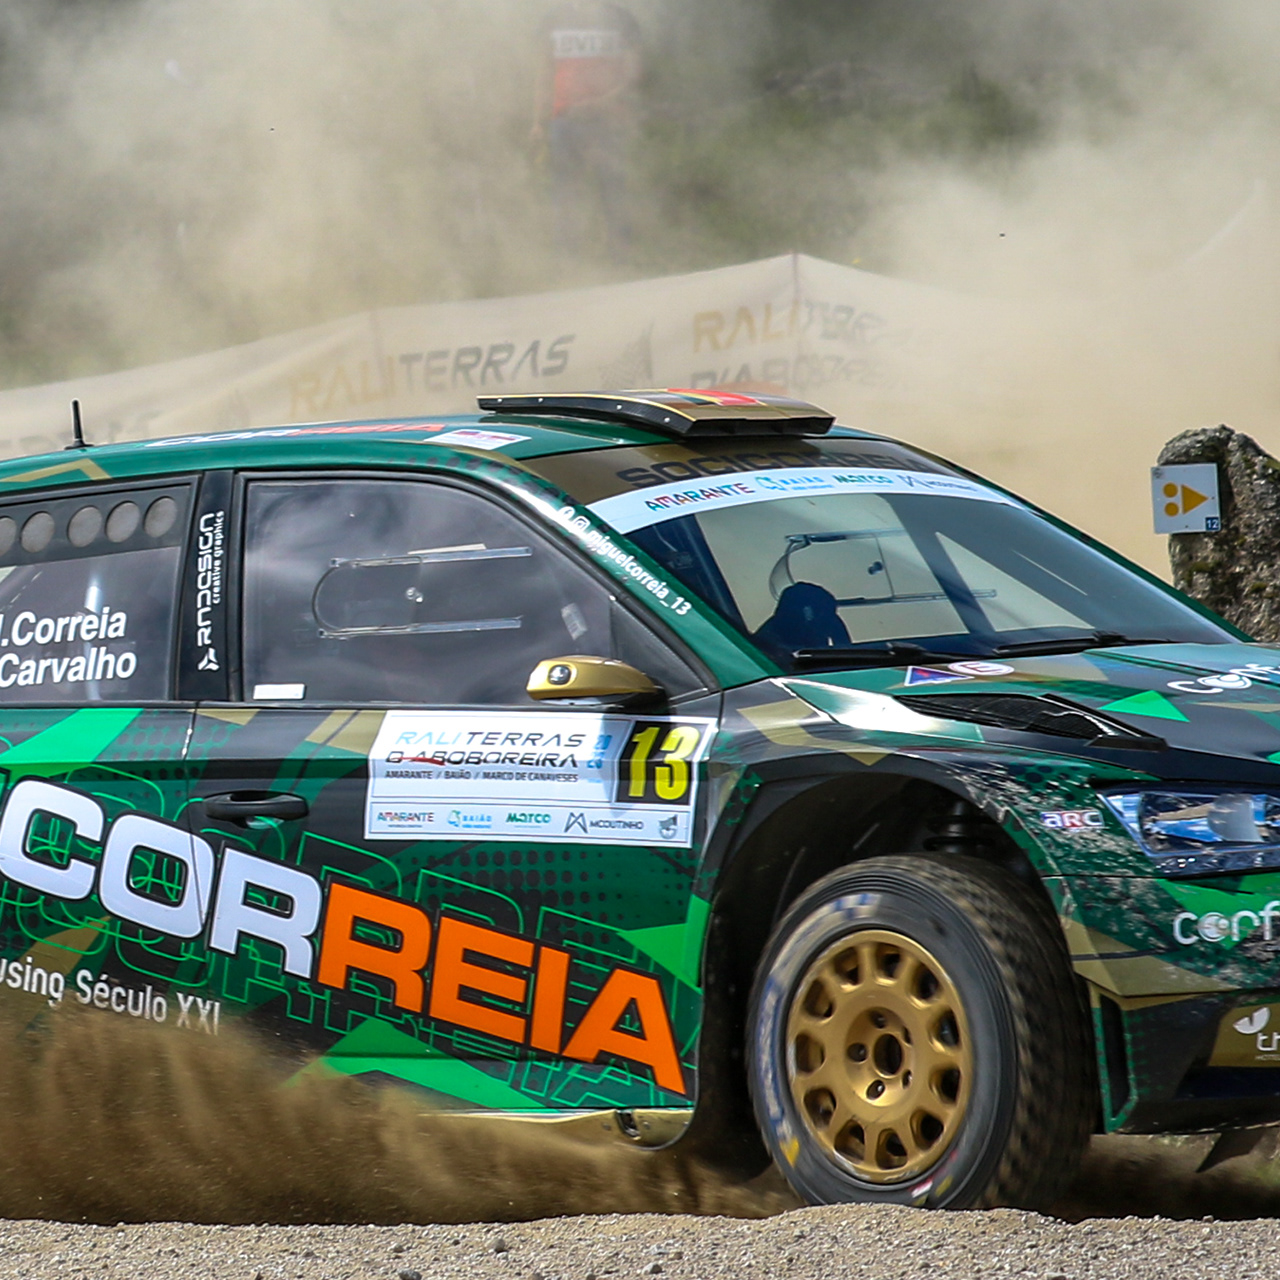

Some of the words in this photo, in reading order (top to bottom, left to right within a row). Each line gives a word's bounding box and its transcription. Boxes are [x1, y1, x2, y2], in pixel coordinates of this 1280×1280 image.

[644, 482, 756, 513] AMARANTE
[213, 510, 225, 558] graphics
[1206, 519, 1219, 529] 12
[212, 559, 222, 605] creative
[384, 770, 433, 780] AMARANTE
[444, 768, 472, 780] BAIÃO
[482, 771, 515, 781] MARCO
[515, 772, 527, 781] DE
[528, 772, 579, 783] CANAVESES
[628, 726, 701, 800] 13
[377, 812, 434, 823] AMARANTE
[589, 819, 645, 831] MCOUTINHO
[75, 968, 168, 1025] Século
[176, 992, 220, 1036] XXI
